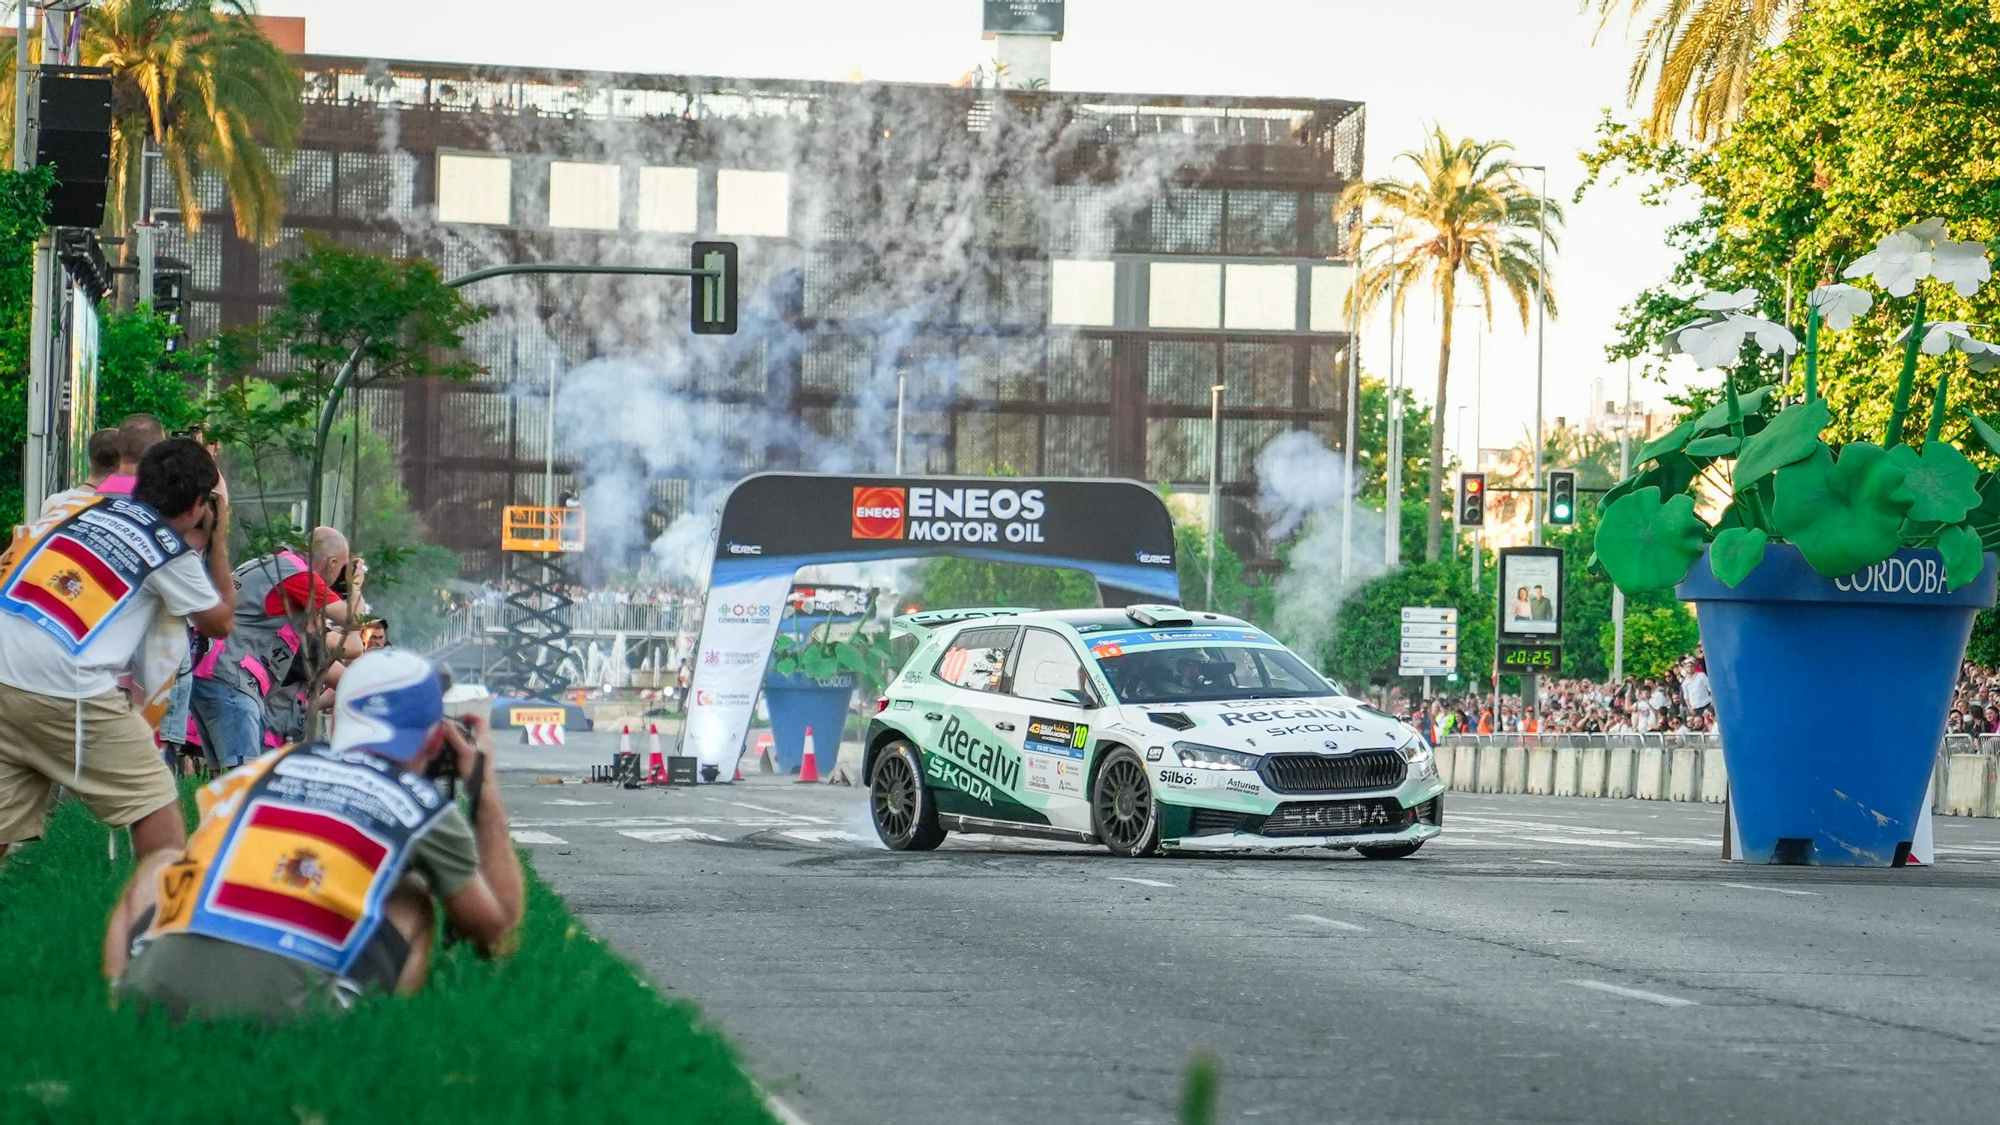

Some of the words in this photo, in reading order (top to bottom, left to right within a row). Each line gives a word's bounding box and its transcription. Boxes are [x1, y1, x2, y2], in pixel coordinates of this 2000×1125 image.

[856, 507, 900, 519] ENEOS
[909, 487, 1045, 520] ENEOS
[84, 513, 155, 564] PHOTOGRAPHER
[157, 530, 177, 553] FIA
[909, 521, 998, 542] MOTOR
[1005, 522, 1044, 543] OIL
[103, 532, 139, 565] ANDALUSIA
[559, 540, 583, 551] JCB
[112, 548, 139, 575] MORENA
[271, 647, 290, 663] 47
[1090, 643, 1123, 658] 10
[1506, 650, 1551, 664] 20:25
[942, 646, 968, 683] 10
[515, 711, 560, 722] PIRELLI
[1218, 707, 1363, 727] Recalvi
[1073, 724, 1088, 749] 10
[938, 713, 1022, 792] Recalvi
[1159, 769, 1197, 785] Silbö:
[1226, 777, 1260, 791] Asturias
